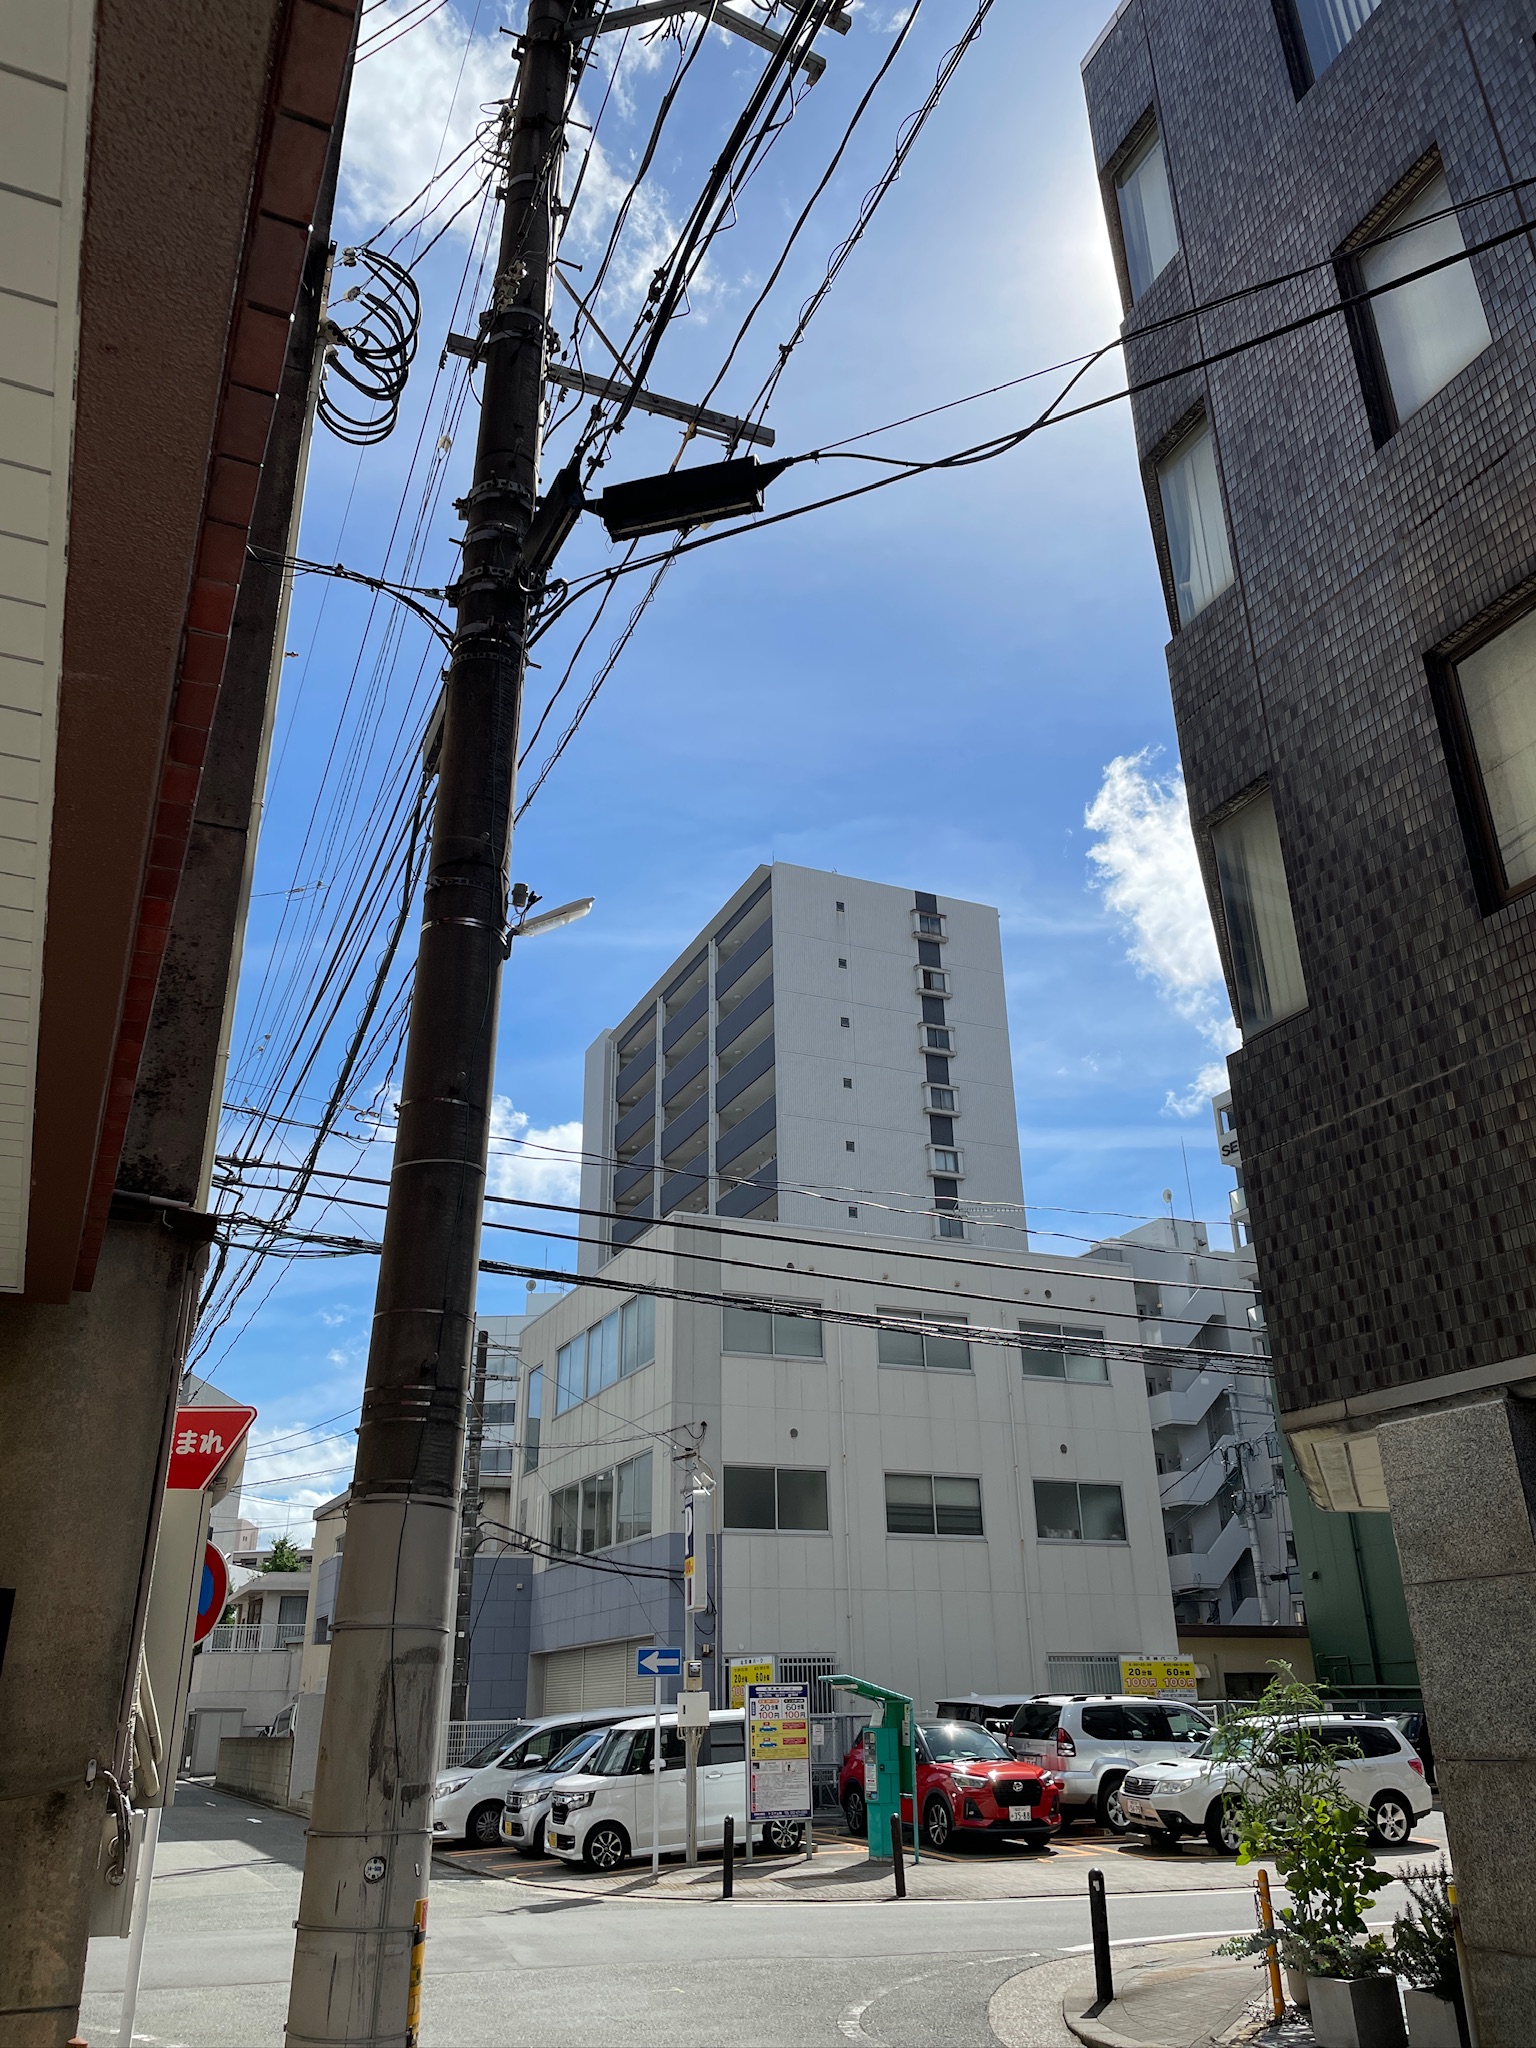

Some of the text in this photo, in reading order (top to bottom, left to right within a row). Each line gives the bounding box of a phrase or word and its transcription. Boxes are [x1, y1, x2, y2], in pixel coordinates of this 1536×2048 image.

[171, 1429, 224, 1455] まれ
[1125, 1677, 1195, 1688] 100円 100円
